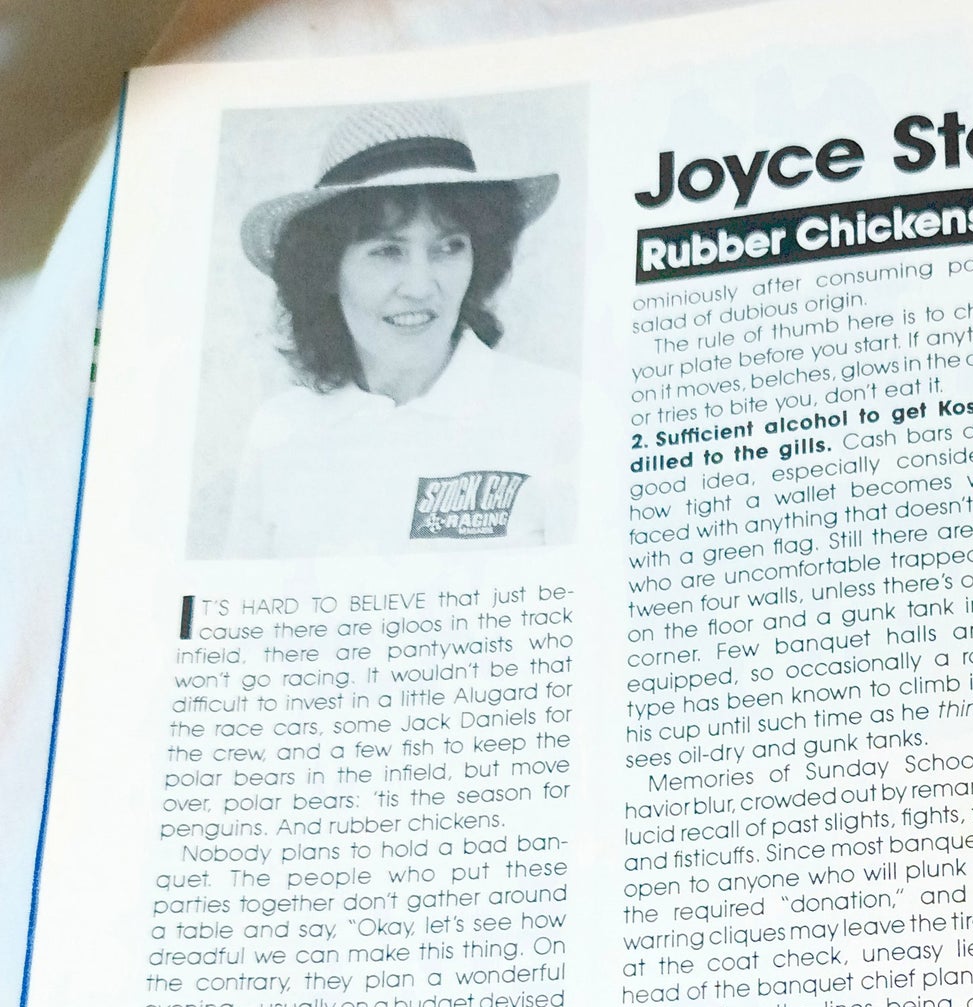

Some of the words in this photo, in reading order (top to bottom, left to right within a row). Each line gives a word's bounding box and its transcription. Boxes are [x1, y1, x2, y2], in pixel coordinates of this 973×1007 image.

[635, 138, 865, 210] Joyce
[640, 228, 787, 272] Rubber
[632, 433, 648, 449] 2.
[656, 421, 753, 447] Sufficient
[765, 410, 847, 434] alcohol
[859, 408, 880, 424] to
[892, 402, 927, 425] get
[630, 451, 693, 473] dilled
[703, 450, 723, 466] to
[734, 445, 768, 462] the
[779, 437, 831, 461] gills.
[843, 429, 896, 450] Cash
[907, 428, 952, 444] bars
[628, 576, 672, 593] who
[681, 573, 715, 589] are
[725, 554, 881, 584] uncomfortable
[172, 696, 248, 713] difficult
[257, 696, 277, 712] to
[286, 693, 343, 712] invest
[352, 690, 371, 709] in
[378, 694, 392, 708] a
[401, 689, 445, 707] little
[453, 682, 538, 706] Alugard
[546, 681, 573, 699] for
[170, 721, 205, 737] the
[215, 723, 263, 737] race
[273, 722, 323, 736] cars,
[333, 719, 392, 734] some
[401, 713, 451, 732] Jack
[461, 708, 536, 729] Daniels
[545, 706, 573, 723] for
[649, 769, 754, 792] Memories
[769, 764, 790, 783] of
[806, 759, 889, 780] Sunday
[182, 844, 272, 865] Nobody
[281, 843, 340, 864] plans
[350, 842, 371, 859] to
[382, 839, 428, 858] hold
[438, 842, 453, 856] a
[463, 835, 507, 855] bad
[517, 834, 568, 852] ban-
[623, 958, 646, 977] at
[659, 956, 694, 975] the
[707, 951, 759, 972] coat
[773, 946, 848, 968] check,
[863, 945, 943, 963] uneasy
